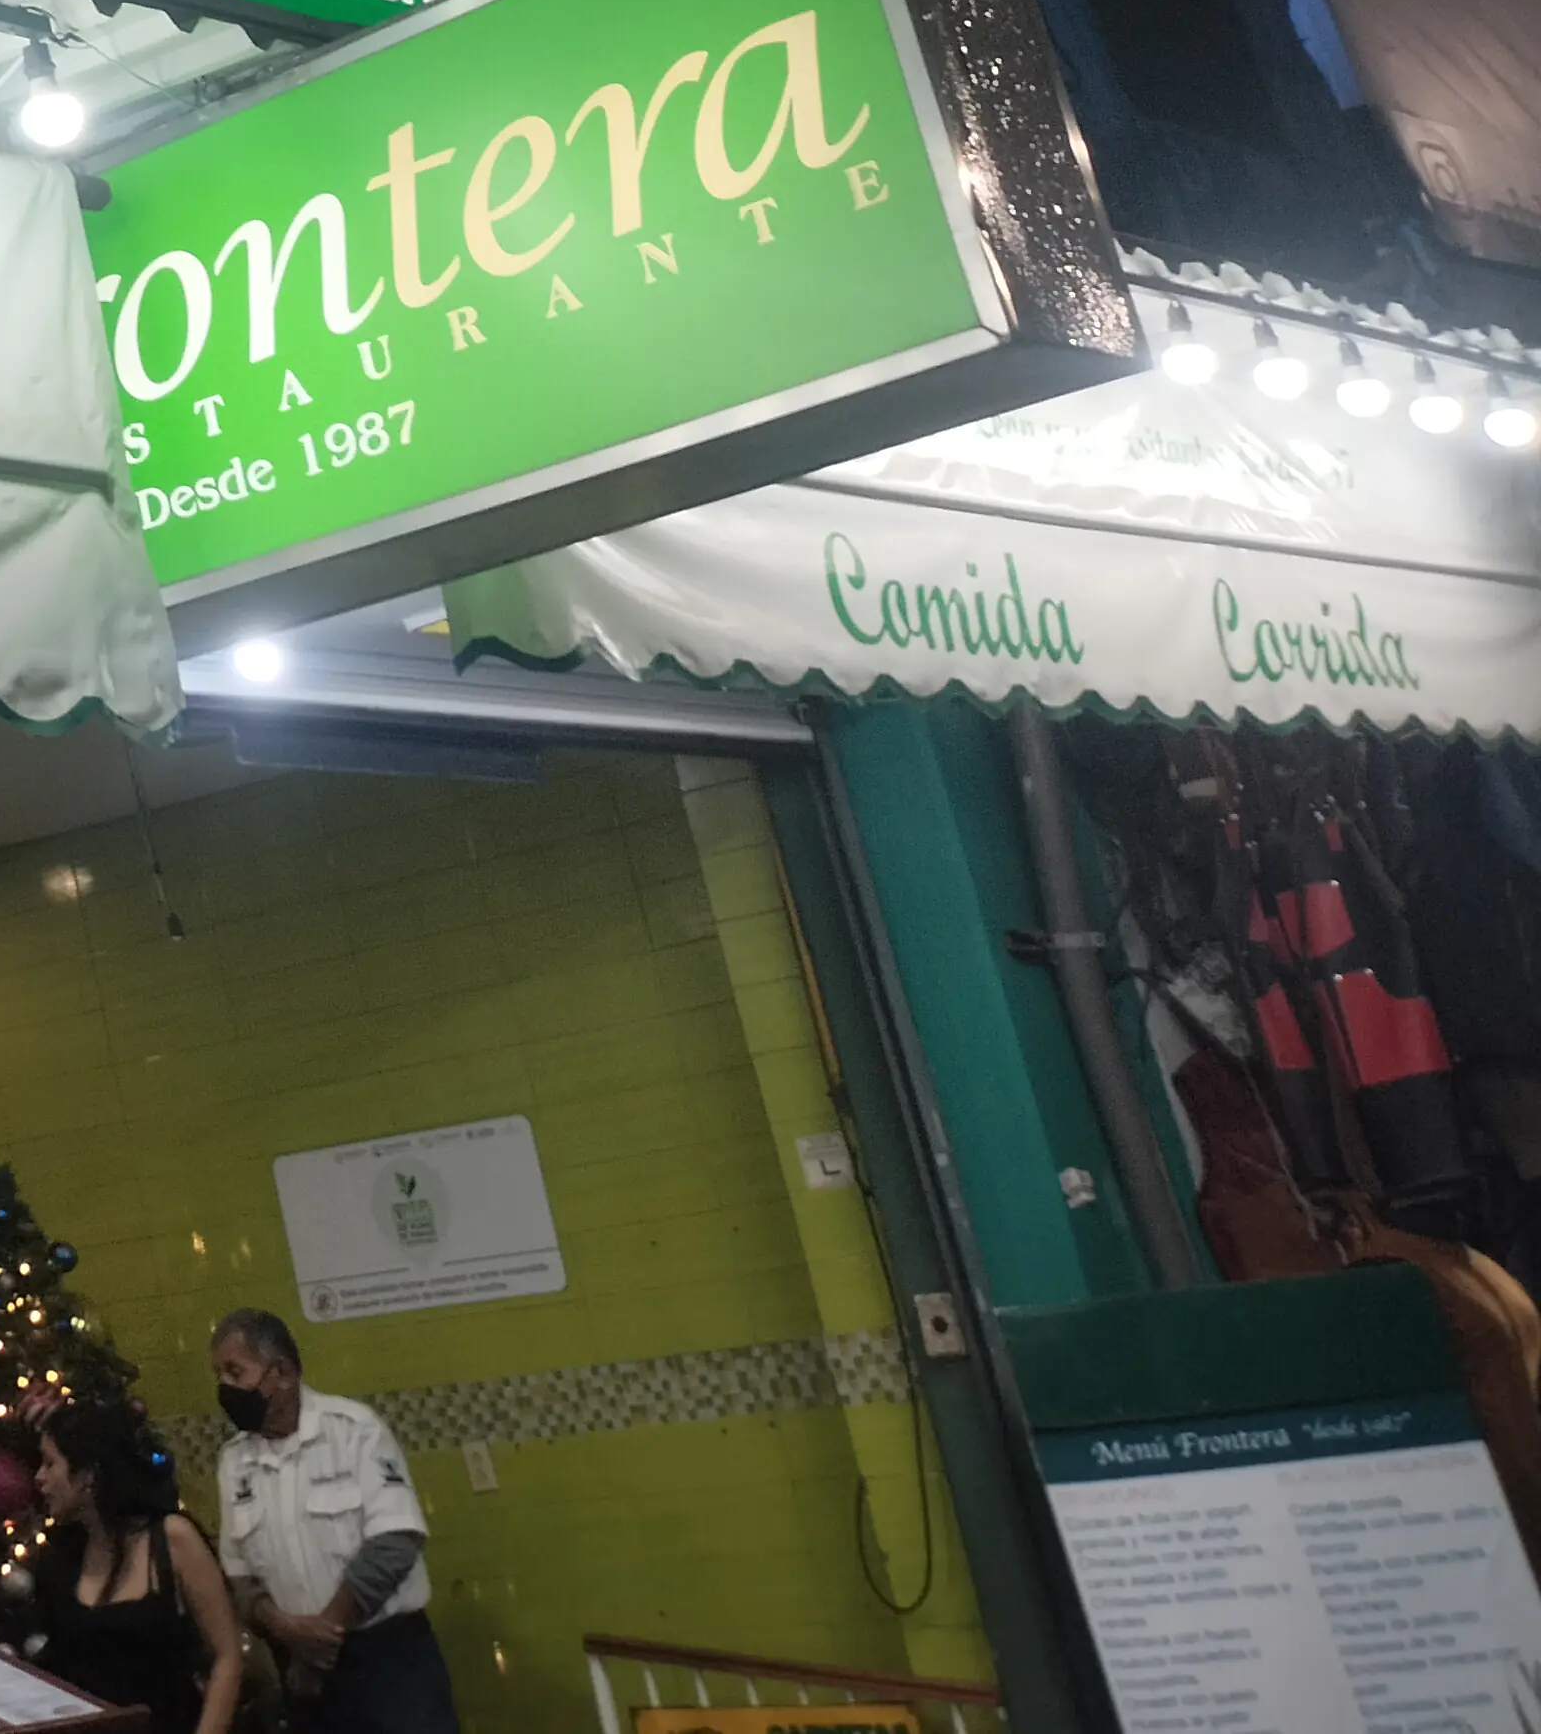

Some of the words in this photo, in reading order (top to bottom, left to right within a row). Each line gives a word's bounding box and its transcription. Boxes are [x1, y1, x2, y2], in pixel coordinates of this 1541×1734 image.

[94, 10, 871, 401] ontera
[134, 456, 277, 530] Desde
[287, 399, 416, 477] 1987
[823, 531, 1085, 666] Comida
[1212, 577, 1421, 690] Corrida
[1173, 1425, 1291, 1458] Frontera
